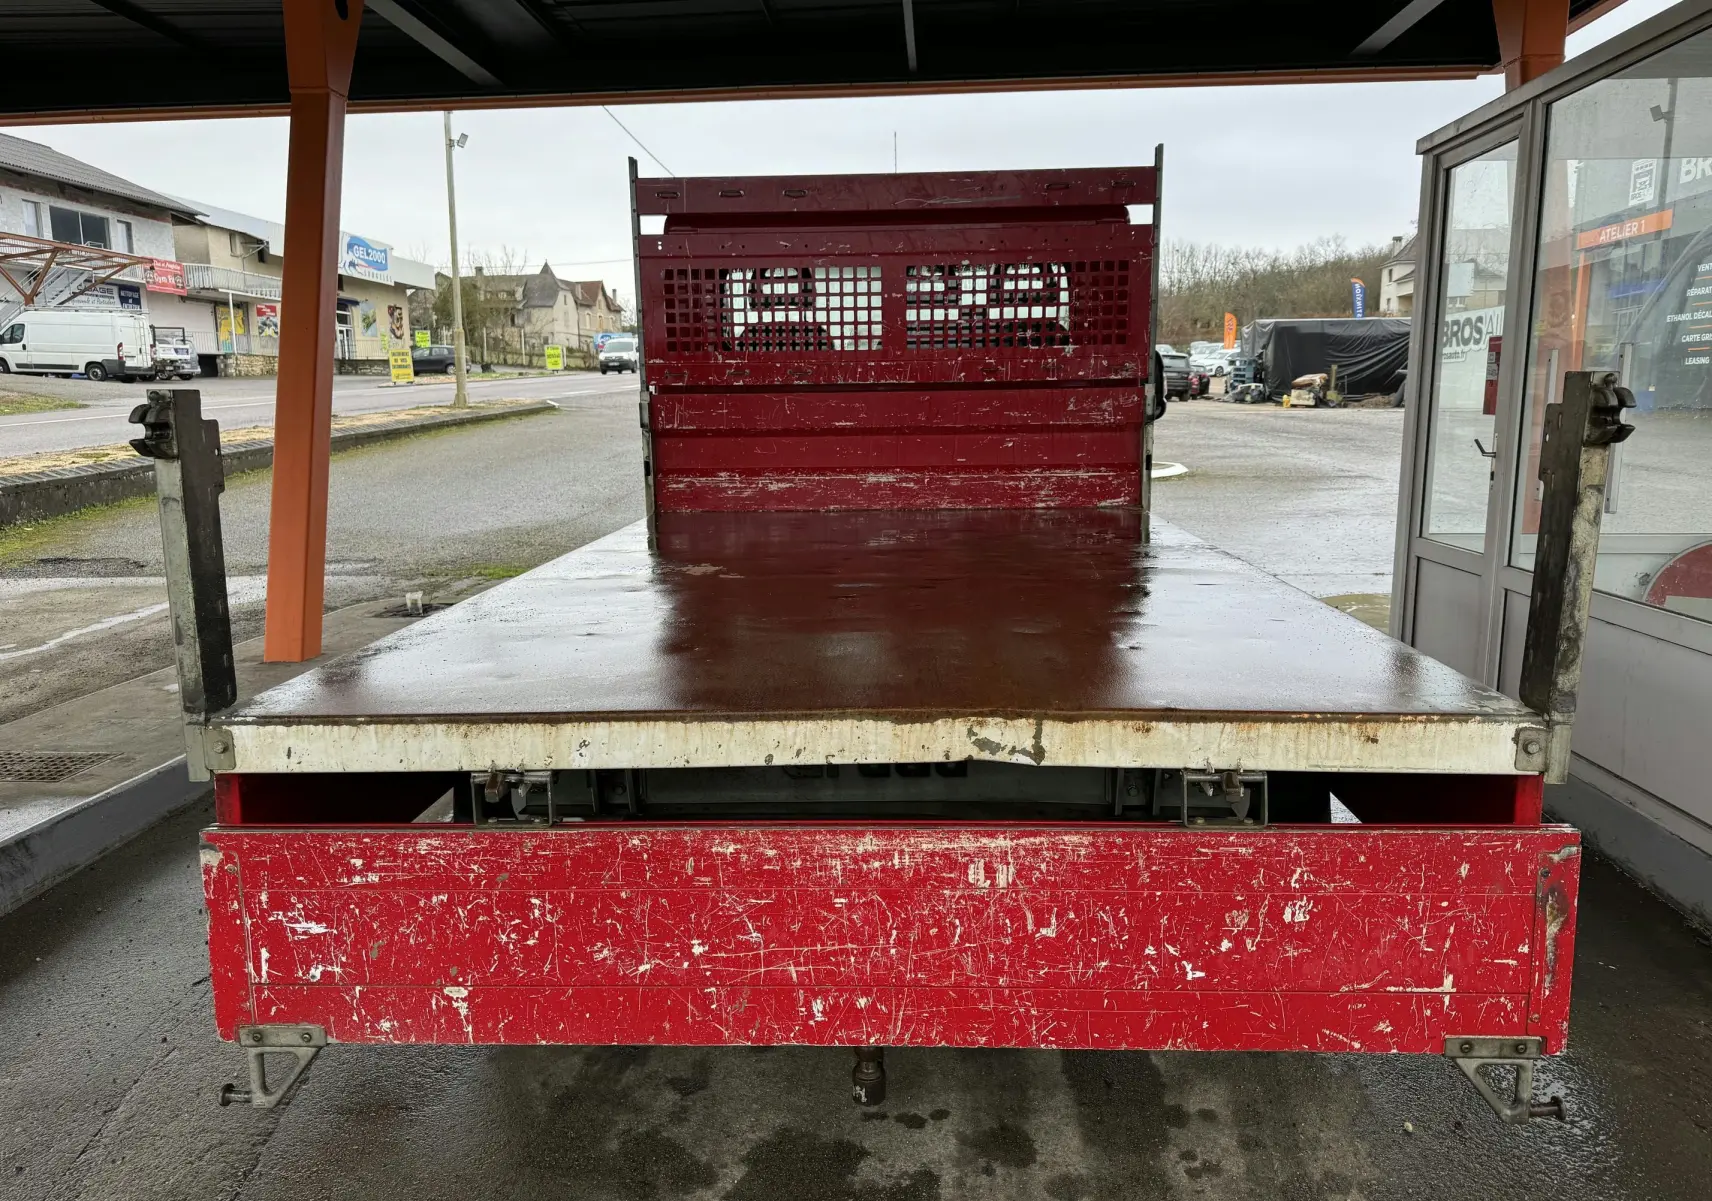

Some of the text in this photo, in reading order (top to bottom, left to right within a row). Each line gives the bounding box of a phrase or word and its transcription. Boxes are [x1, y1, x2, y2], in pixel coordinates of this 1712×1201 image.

[1600, 220, 1646, 242] ATELIER 1
[353, 245, 386, 264] GEL2000
[1666, 313, 1692, 323] ETHANOL
[1681, 333, 1701, 343] CARTE
[1685, 356, 1710, 365] LEASING
